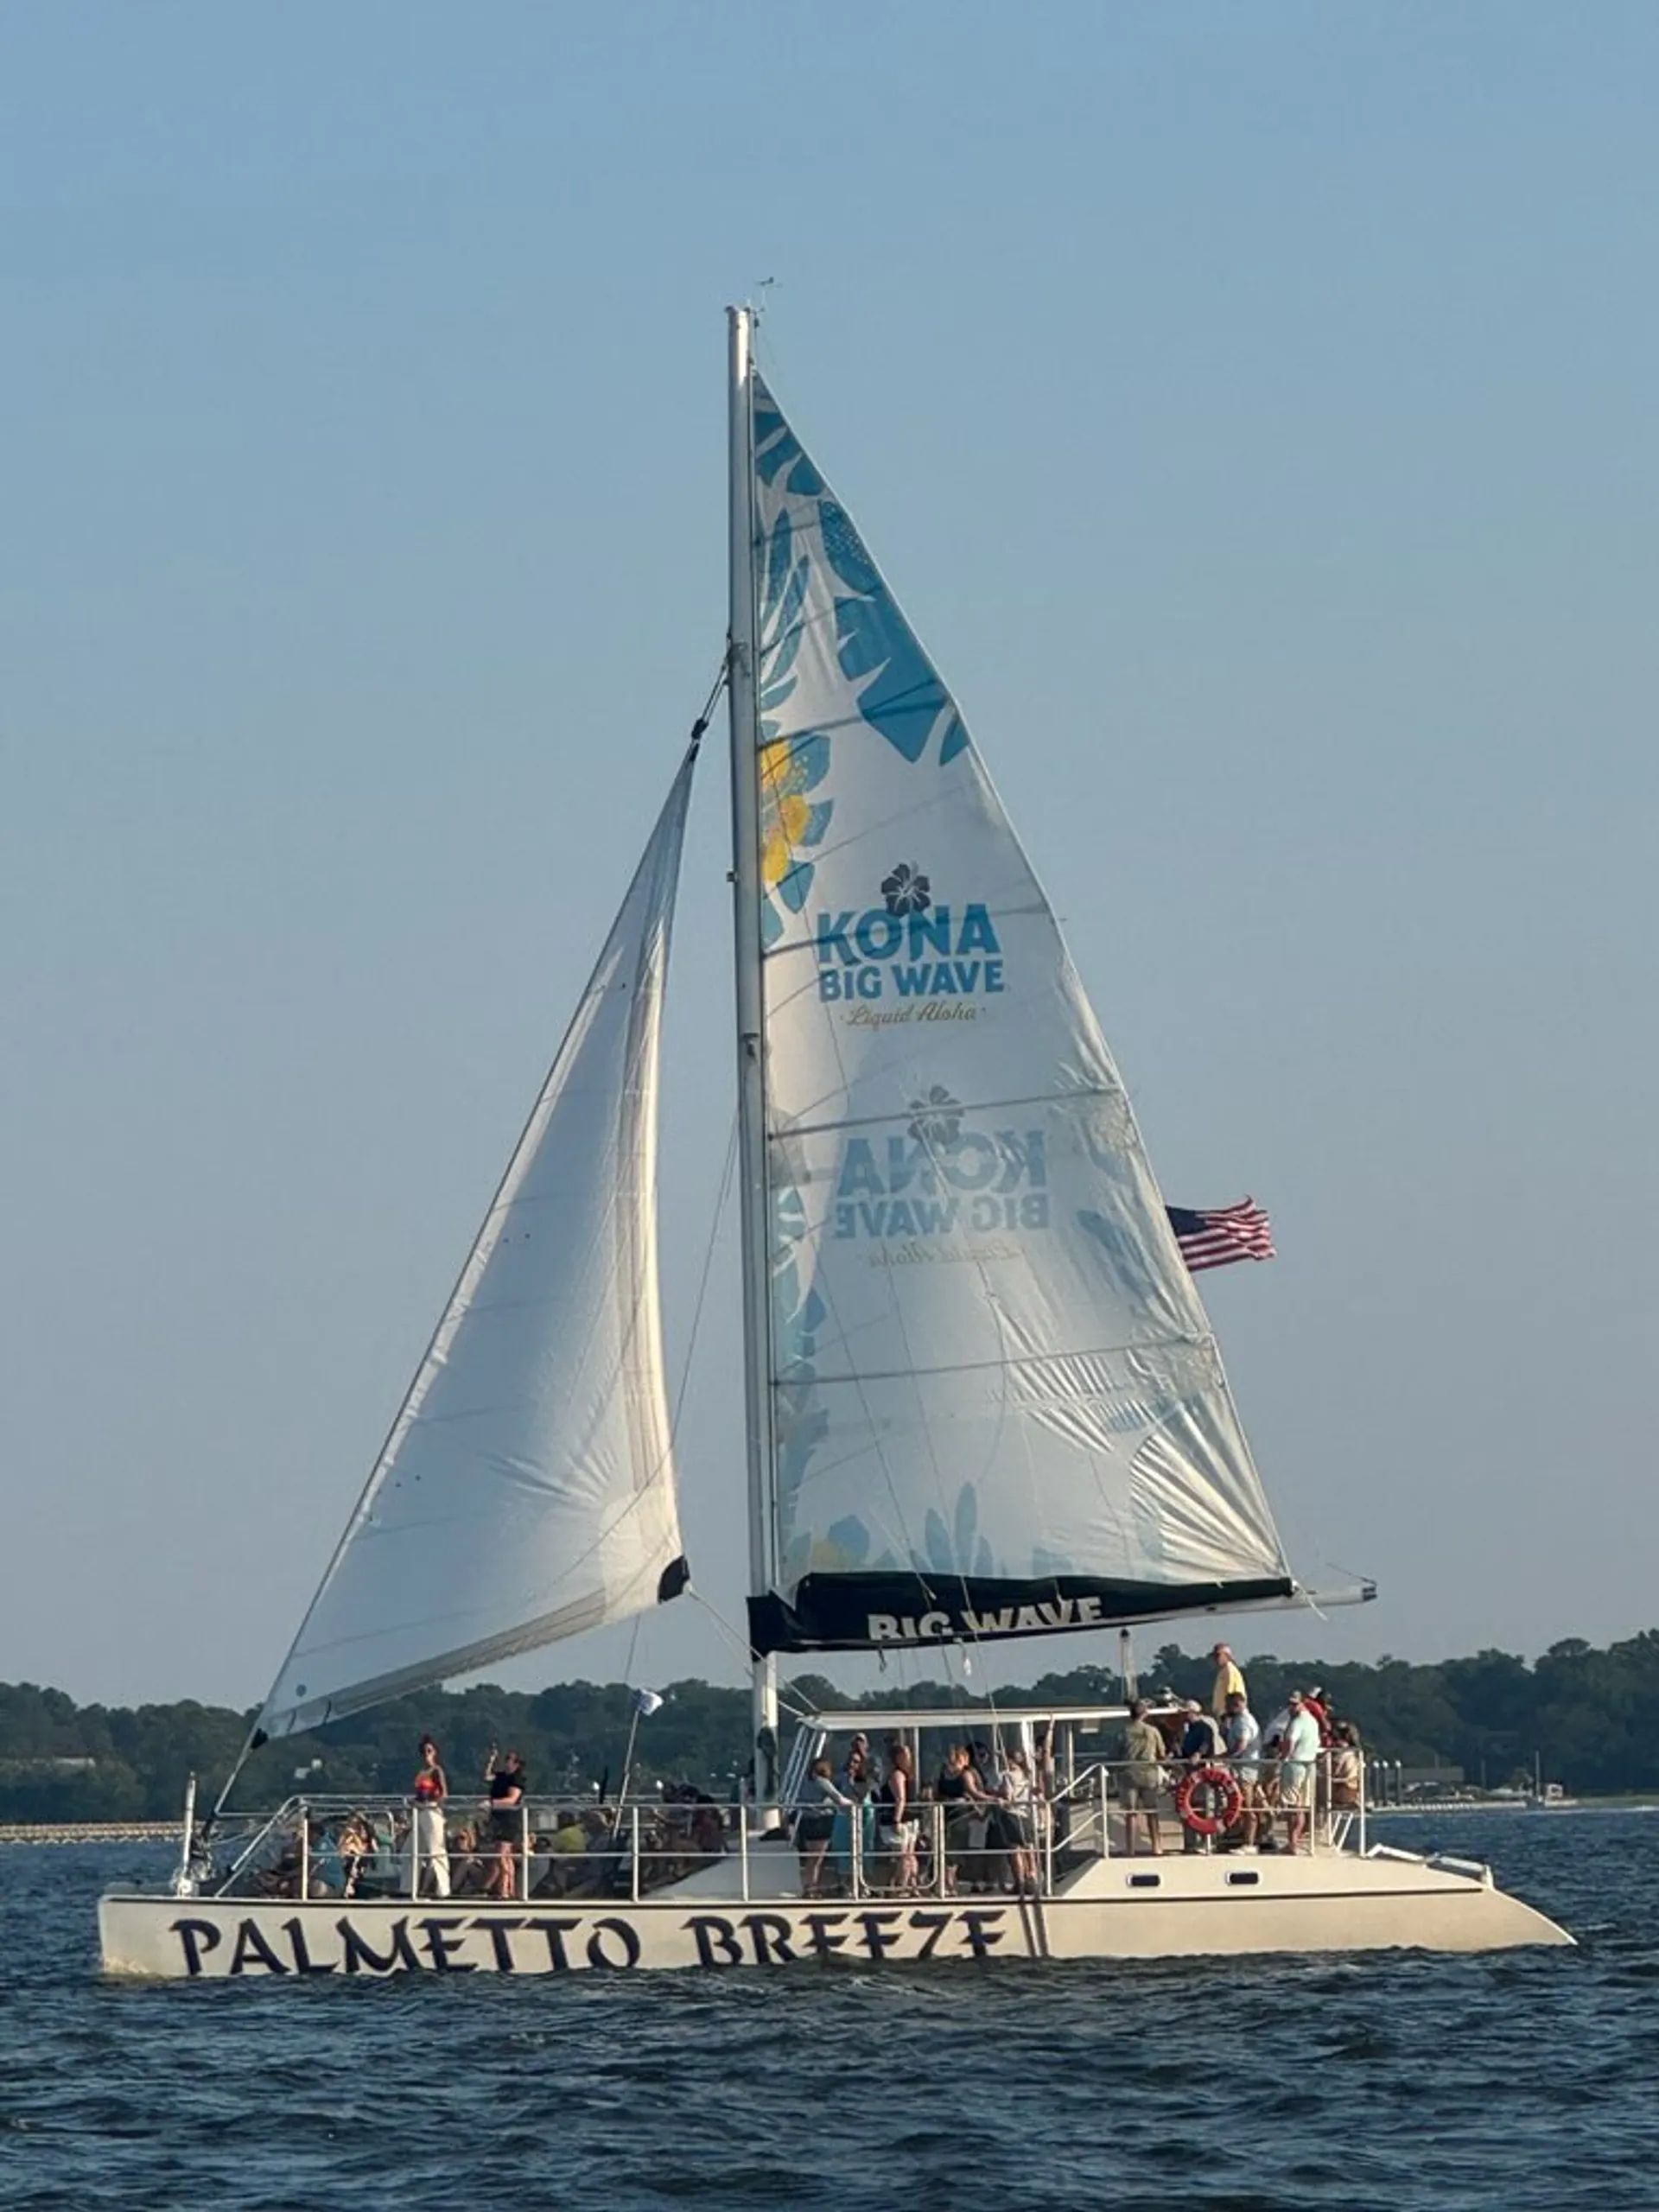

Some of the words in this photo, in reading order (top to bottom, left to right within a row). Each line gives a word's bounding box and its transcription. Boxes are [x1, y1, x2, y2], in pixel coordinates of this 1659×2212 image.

[817, 903, 1001, 966] KONA
[818, 965, 882, 1003] BIG
[891, 959, 1005, 997] WAVE
[846, 1003, 914, 1032] Liquid
[916, 1001, 977, 1023] Aloha
[867, 1611, 954, 1641] BIG
[960, 1595, 1103, 1633] WAVE
[168, 1916, 641, 1976] PALMETTO
[680, 1909, 1007, 1967] BREEZE
